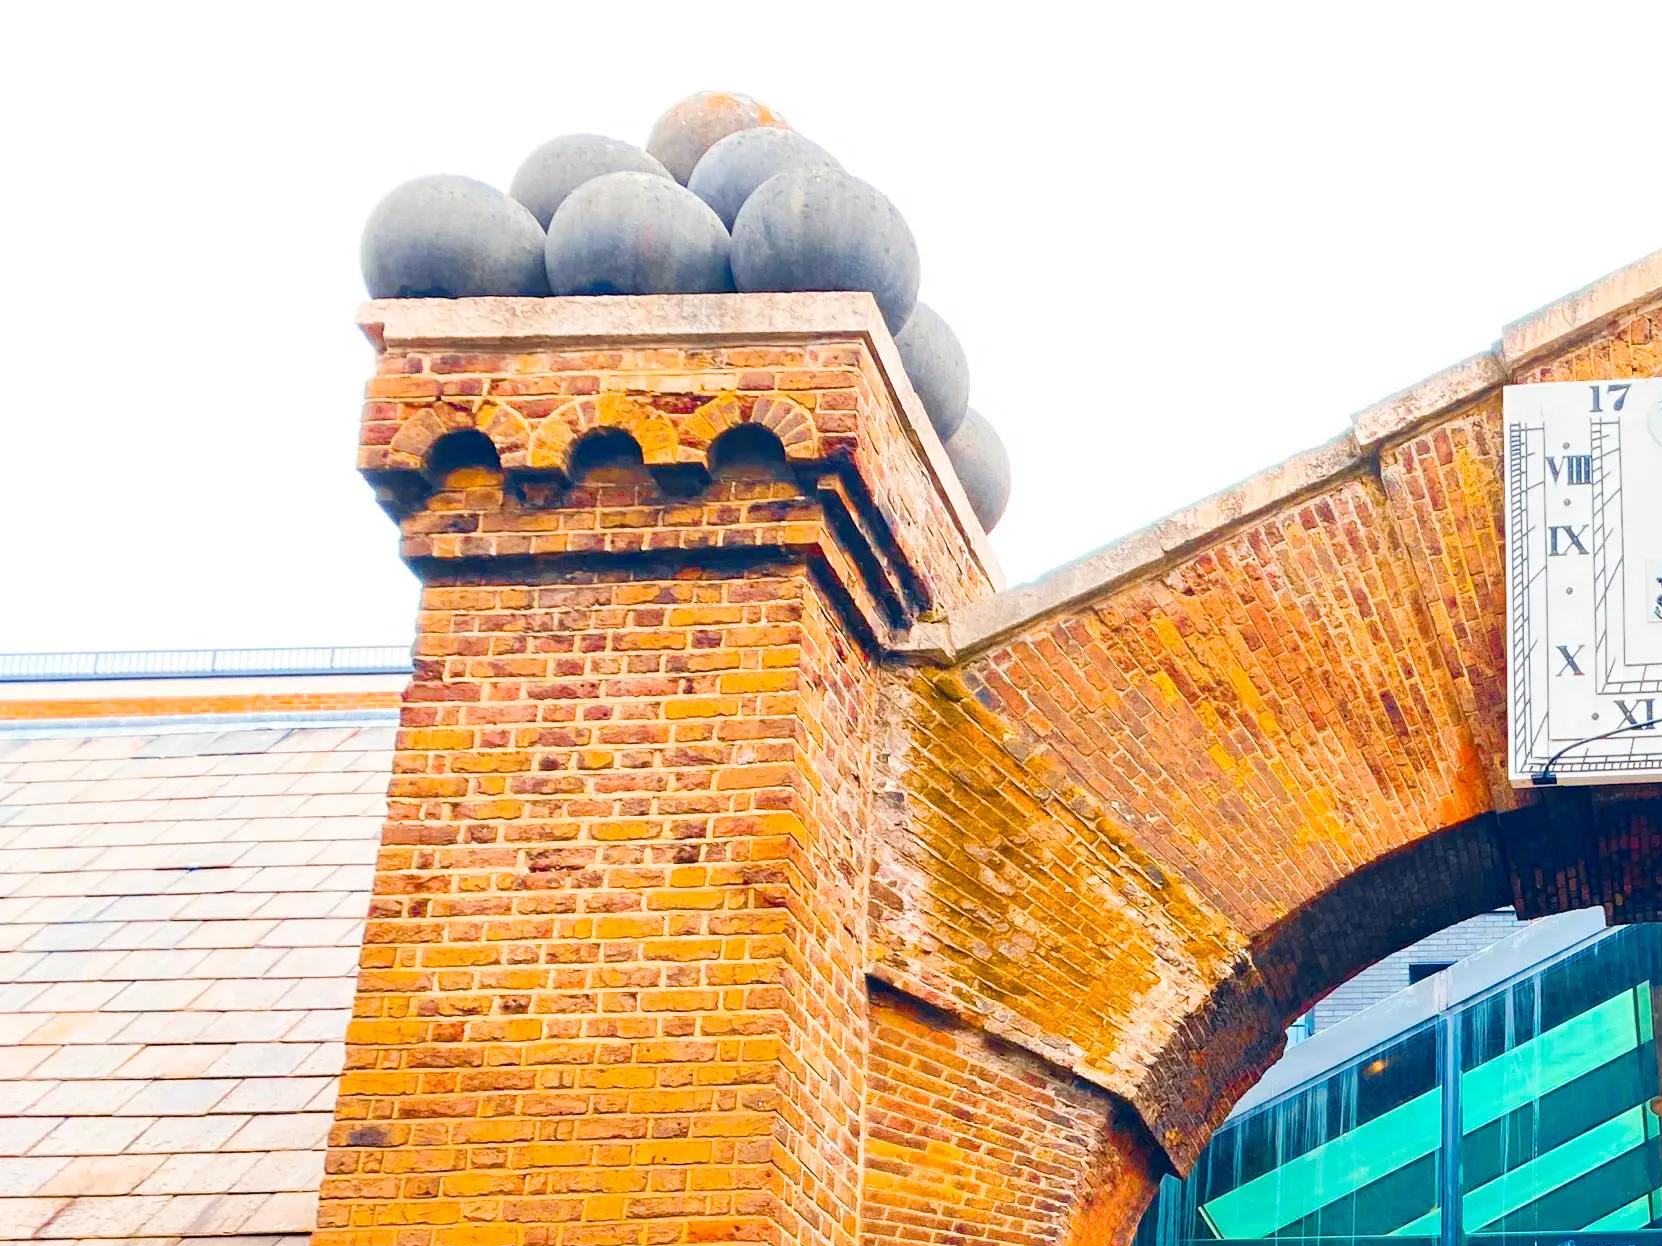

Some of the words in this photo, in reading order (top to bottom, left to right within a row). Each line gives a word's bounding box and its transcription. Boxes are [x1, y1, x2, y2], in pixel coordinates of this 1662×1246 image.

[1589, 384, 1632, 413] 17
[1545, 454, 1593, 486] VIII
[1548, 524, 1589, 557] IX
[1555, 645, 1585, 677] X
[1613, 698, 1656, 730] XI
